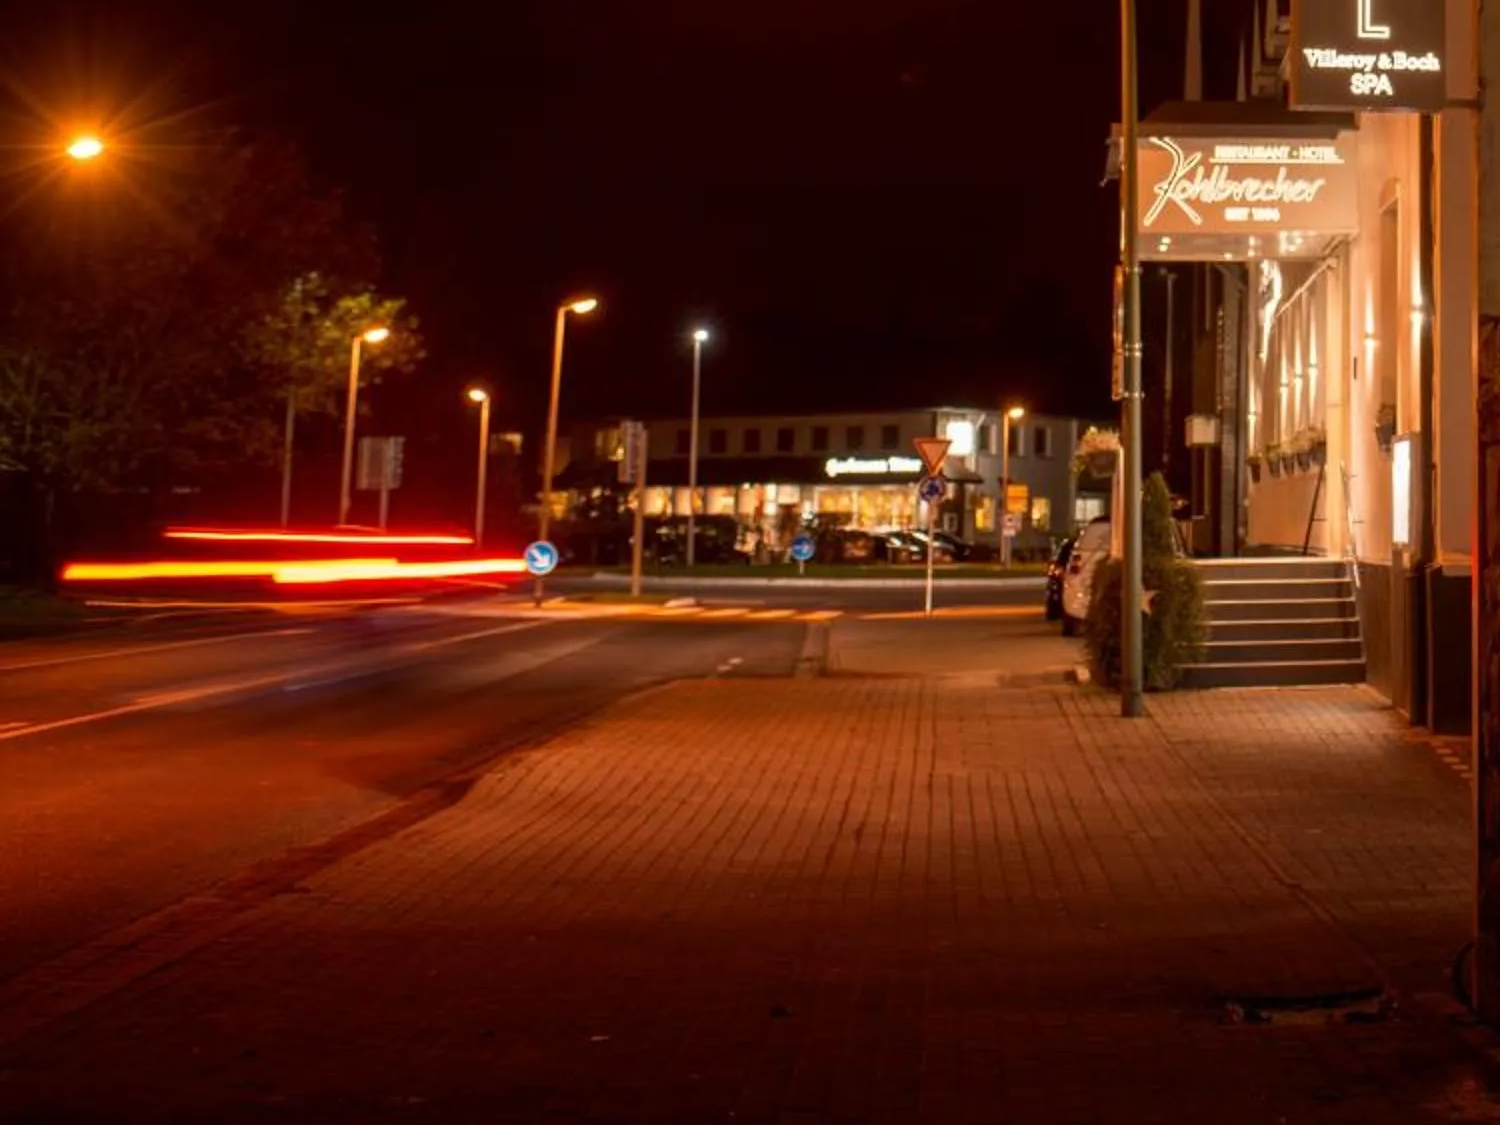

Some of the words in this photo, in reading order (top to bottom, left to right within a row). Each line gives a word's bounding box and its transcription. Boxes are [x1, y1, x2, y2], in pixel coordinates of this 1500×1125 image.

[1302, 47, 1377, 72] Villeroy
[1378, 52, 1393, 70] &
[1392, 51, 1441, 71] Boch
[1350, 72, 1393, 95] SPA
[1143, 136, 1326, 226] Kohlbrecher
